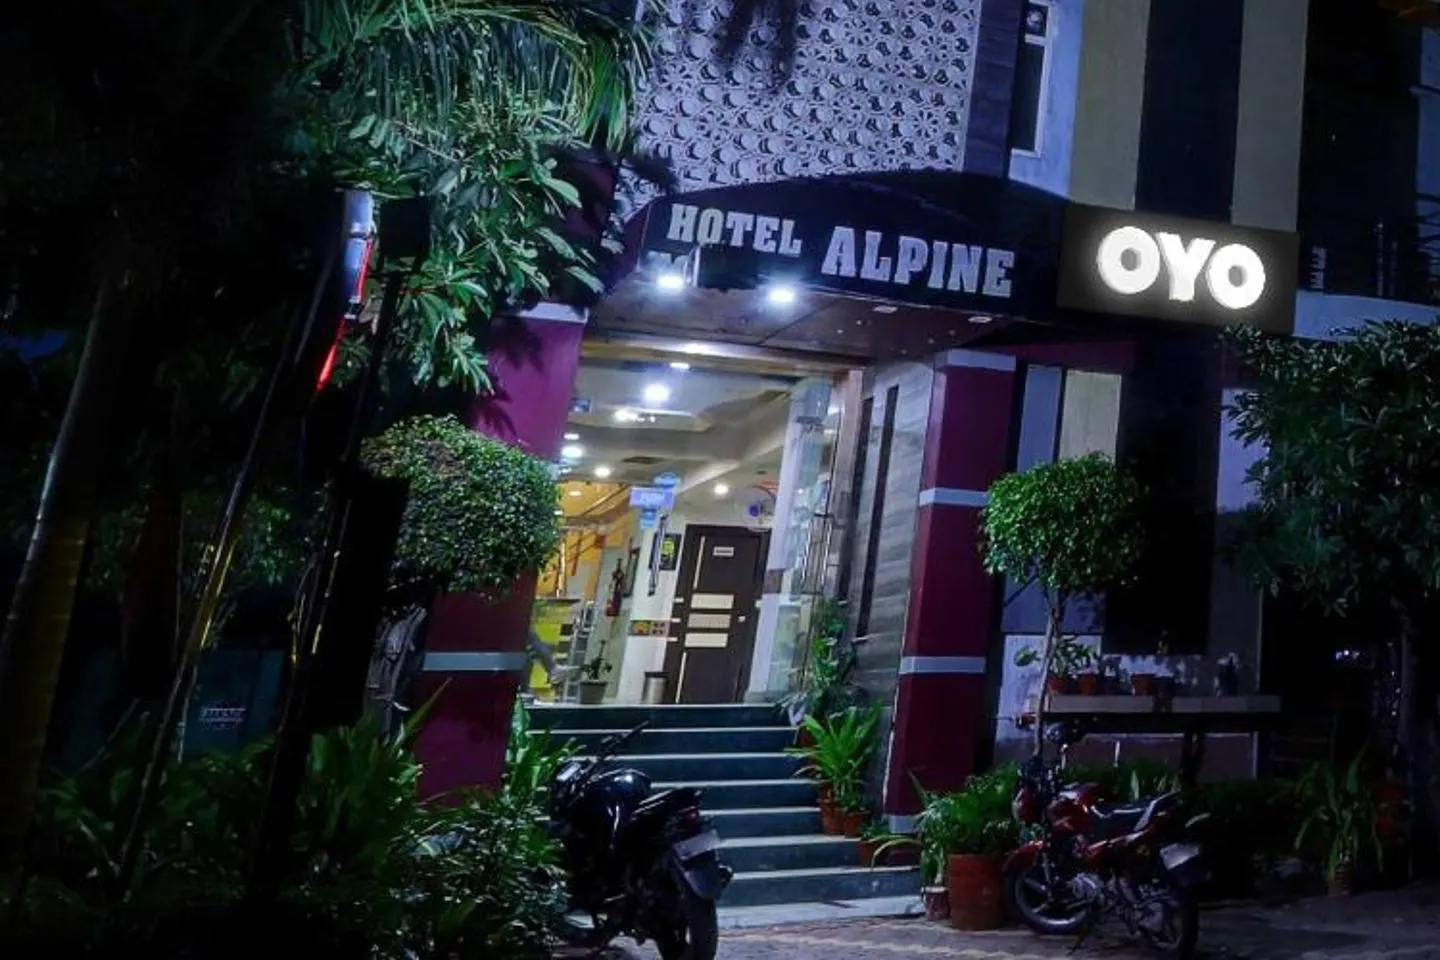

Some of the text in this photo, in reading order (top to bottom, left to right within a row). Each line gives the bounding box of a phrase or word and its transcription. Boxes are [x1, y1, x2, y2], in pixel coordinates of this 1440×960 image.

[667, 203, 1014, 298] HOTEL ALPINE
[1097, 226, 1266, 309] OYO
